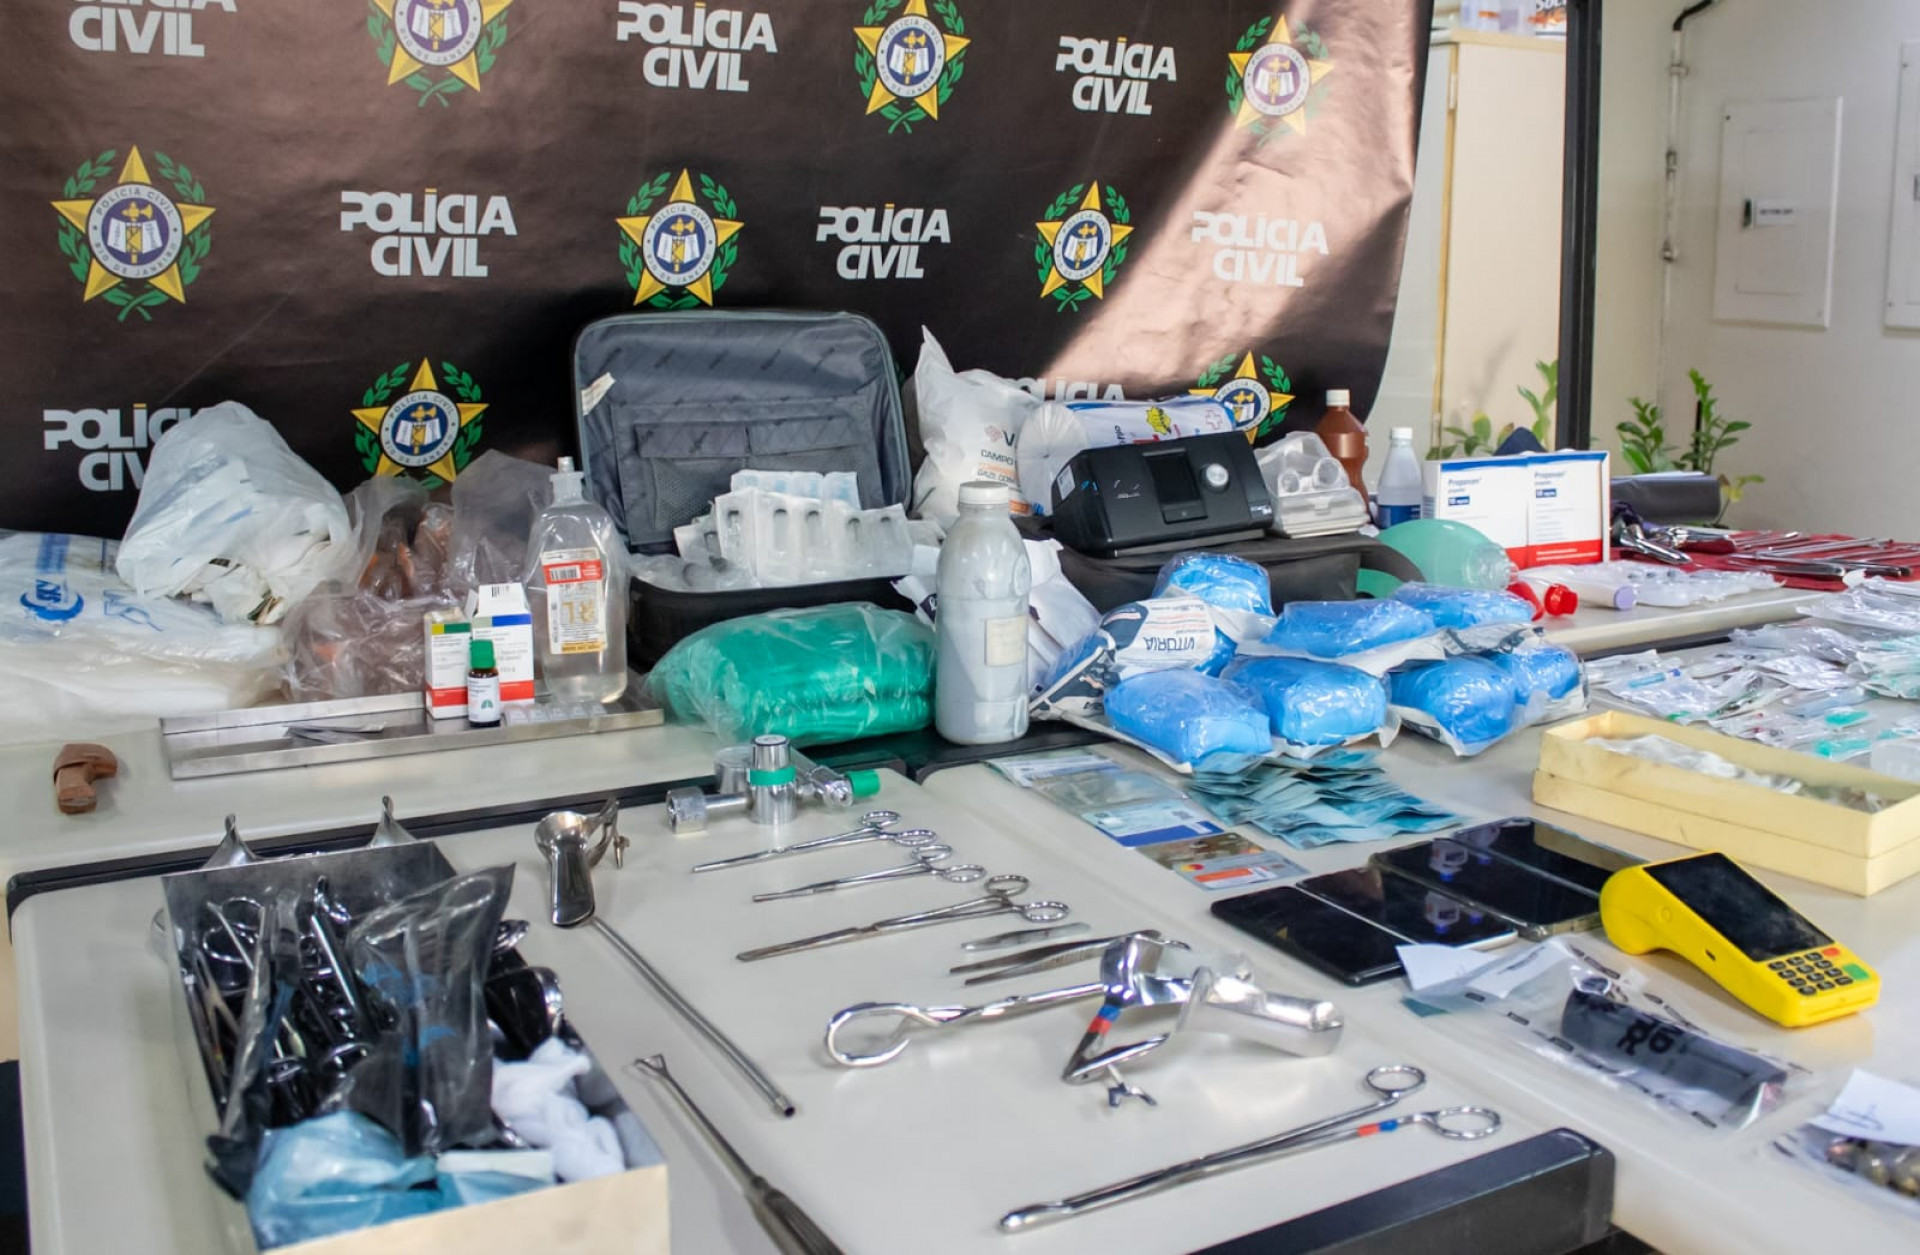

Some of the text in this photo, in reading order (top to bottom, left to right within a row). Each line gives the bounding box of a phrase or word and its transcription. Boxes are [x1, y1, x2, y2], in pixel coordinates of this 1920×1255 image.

[69, 6, 205, 57] CIVIL
[616, 0, 778, 53] POLÍCIA
[642, 47, 750, 92] CIVIL
[1055, 36, 1178, 82] POLÍCIA
[1072, 76, 1153, 115] CIVIL
[340, 188, 518, 236] POLÍCIA
[816, 203, 951, 244] POLÍCIA
[1190, 211, 1330, 256] POLÍCIA
[370, 236, 488, 278] CIVIL
[836, 244, 925, 280] CIVIL
[1212, 248, 1305, 288] CIVIL
